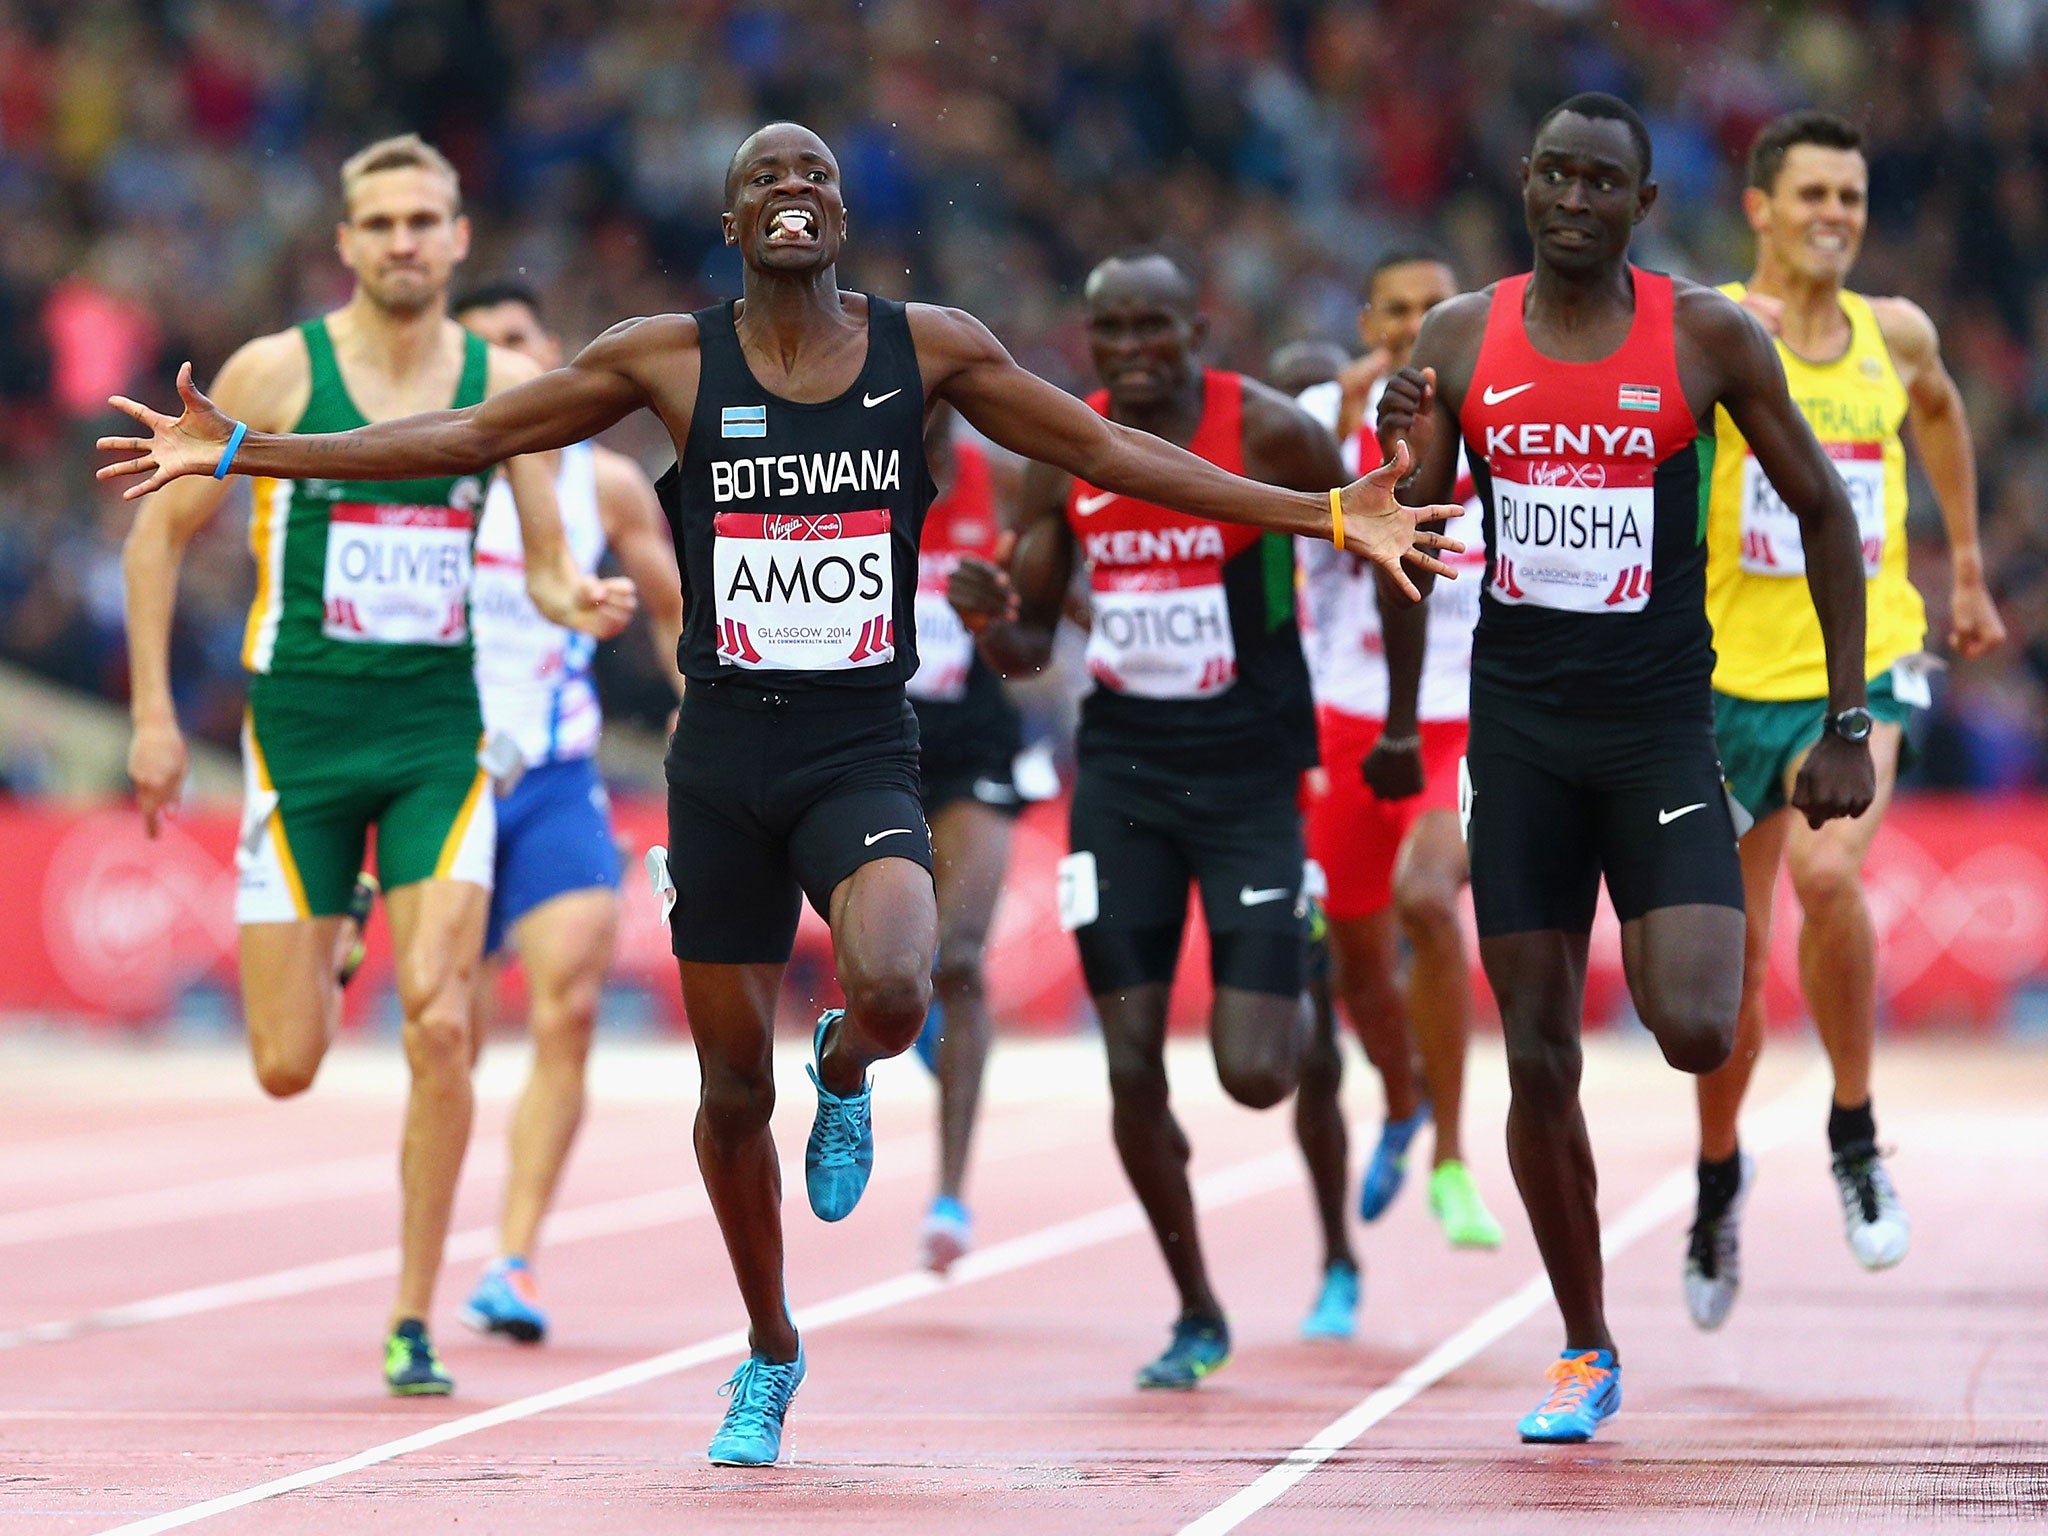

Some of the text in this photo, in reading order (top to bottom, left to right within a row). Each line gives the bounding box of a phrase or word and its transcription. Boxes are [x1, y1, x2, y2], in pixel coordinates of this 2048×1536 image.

[1486, 423, 1656, 458] KENYA
[711, 449, 900, 502] BOTSWANA
[769, 515, 839, 541] Virgin media
[1502, 496, 1641, 549] RUDISHA
[1087, 525, 1224, 564] KENYA
[727, 552, 883, 604] AMOS
[758, 627, 852, 638] GLASGOW 2014
[1100, 603, 1222, 648] OTICH
